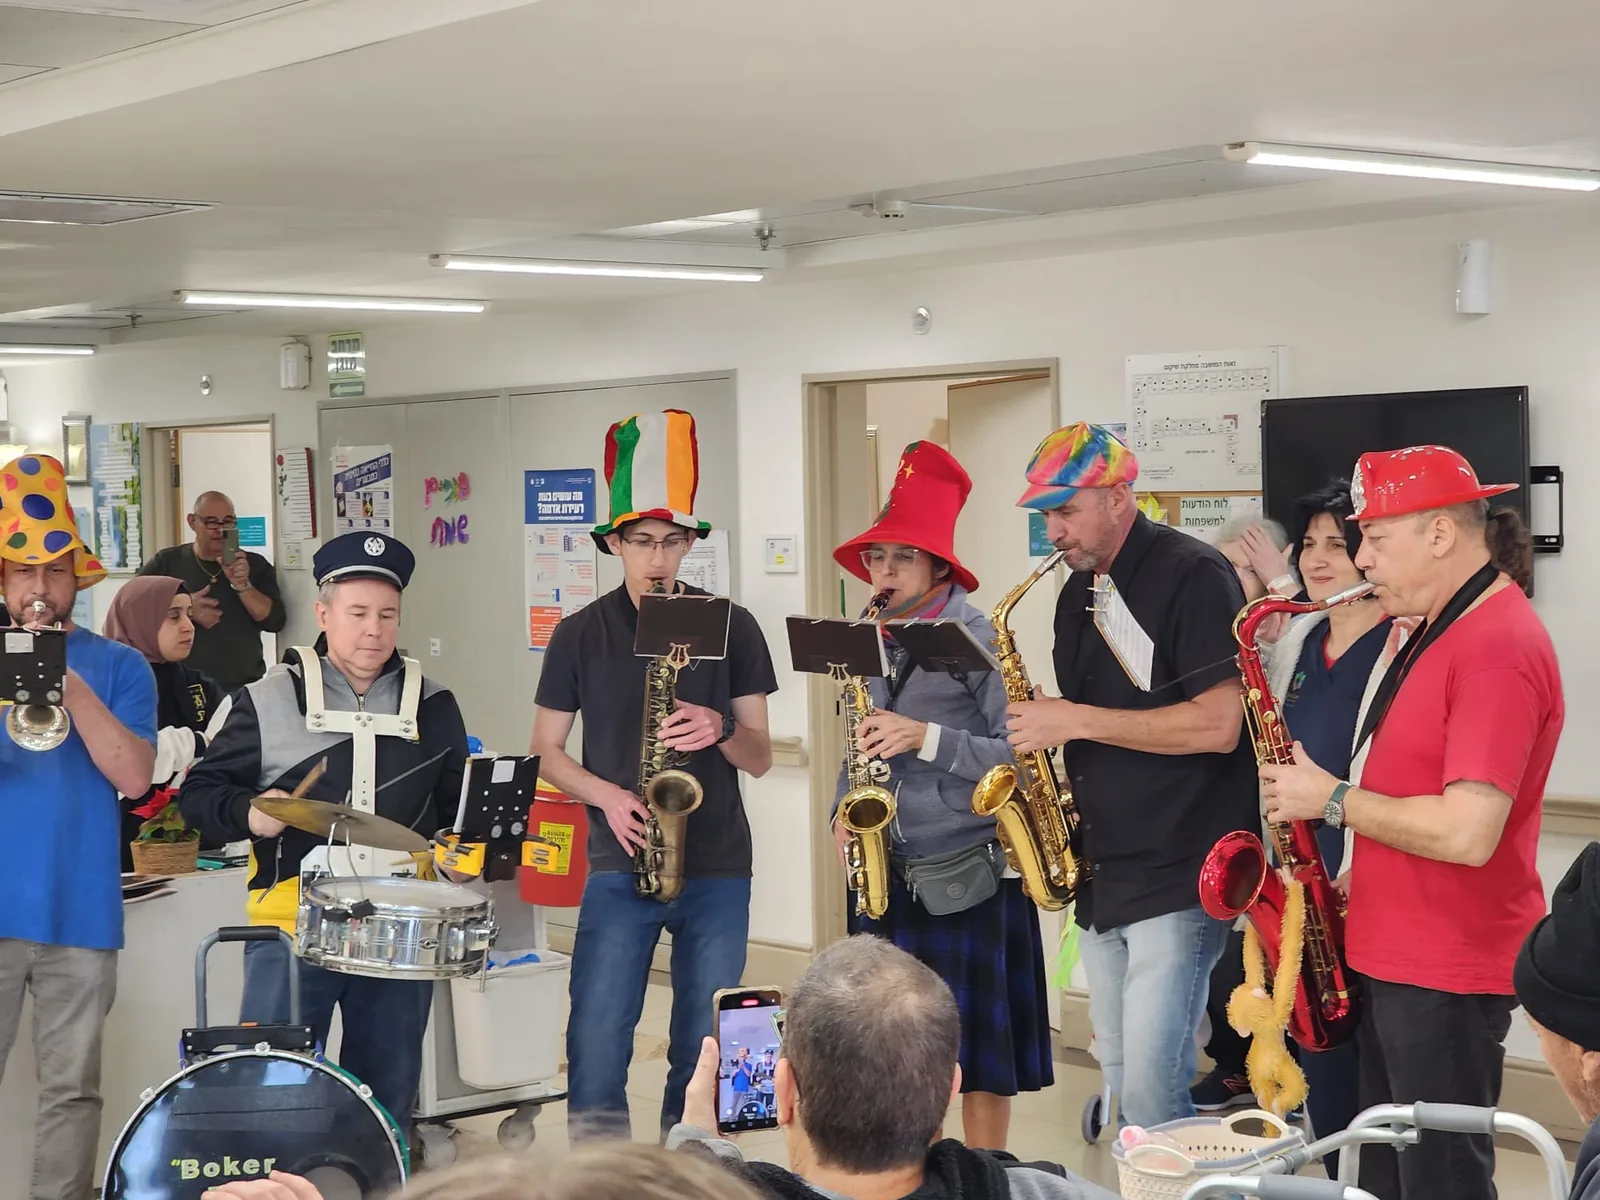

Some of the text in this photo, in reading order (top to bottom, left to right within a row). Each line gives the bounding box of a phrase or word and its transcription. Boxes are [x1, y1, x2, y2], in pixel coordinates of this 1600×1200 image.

[331, 338, 360, 353] מרחב
[336, 357, 357, 374] מוגן
[1181, 497, 1228, 509] לוח הודעות
[1185, 515, 1225, 526] למשפחות
